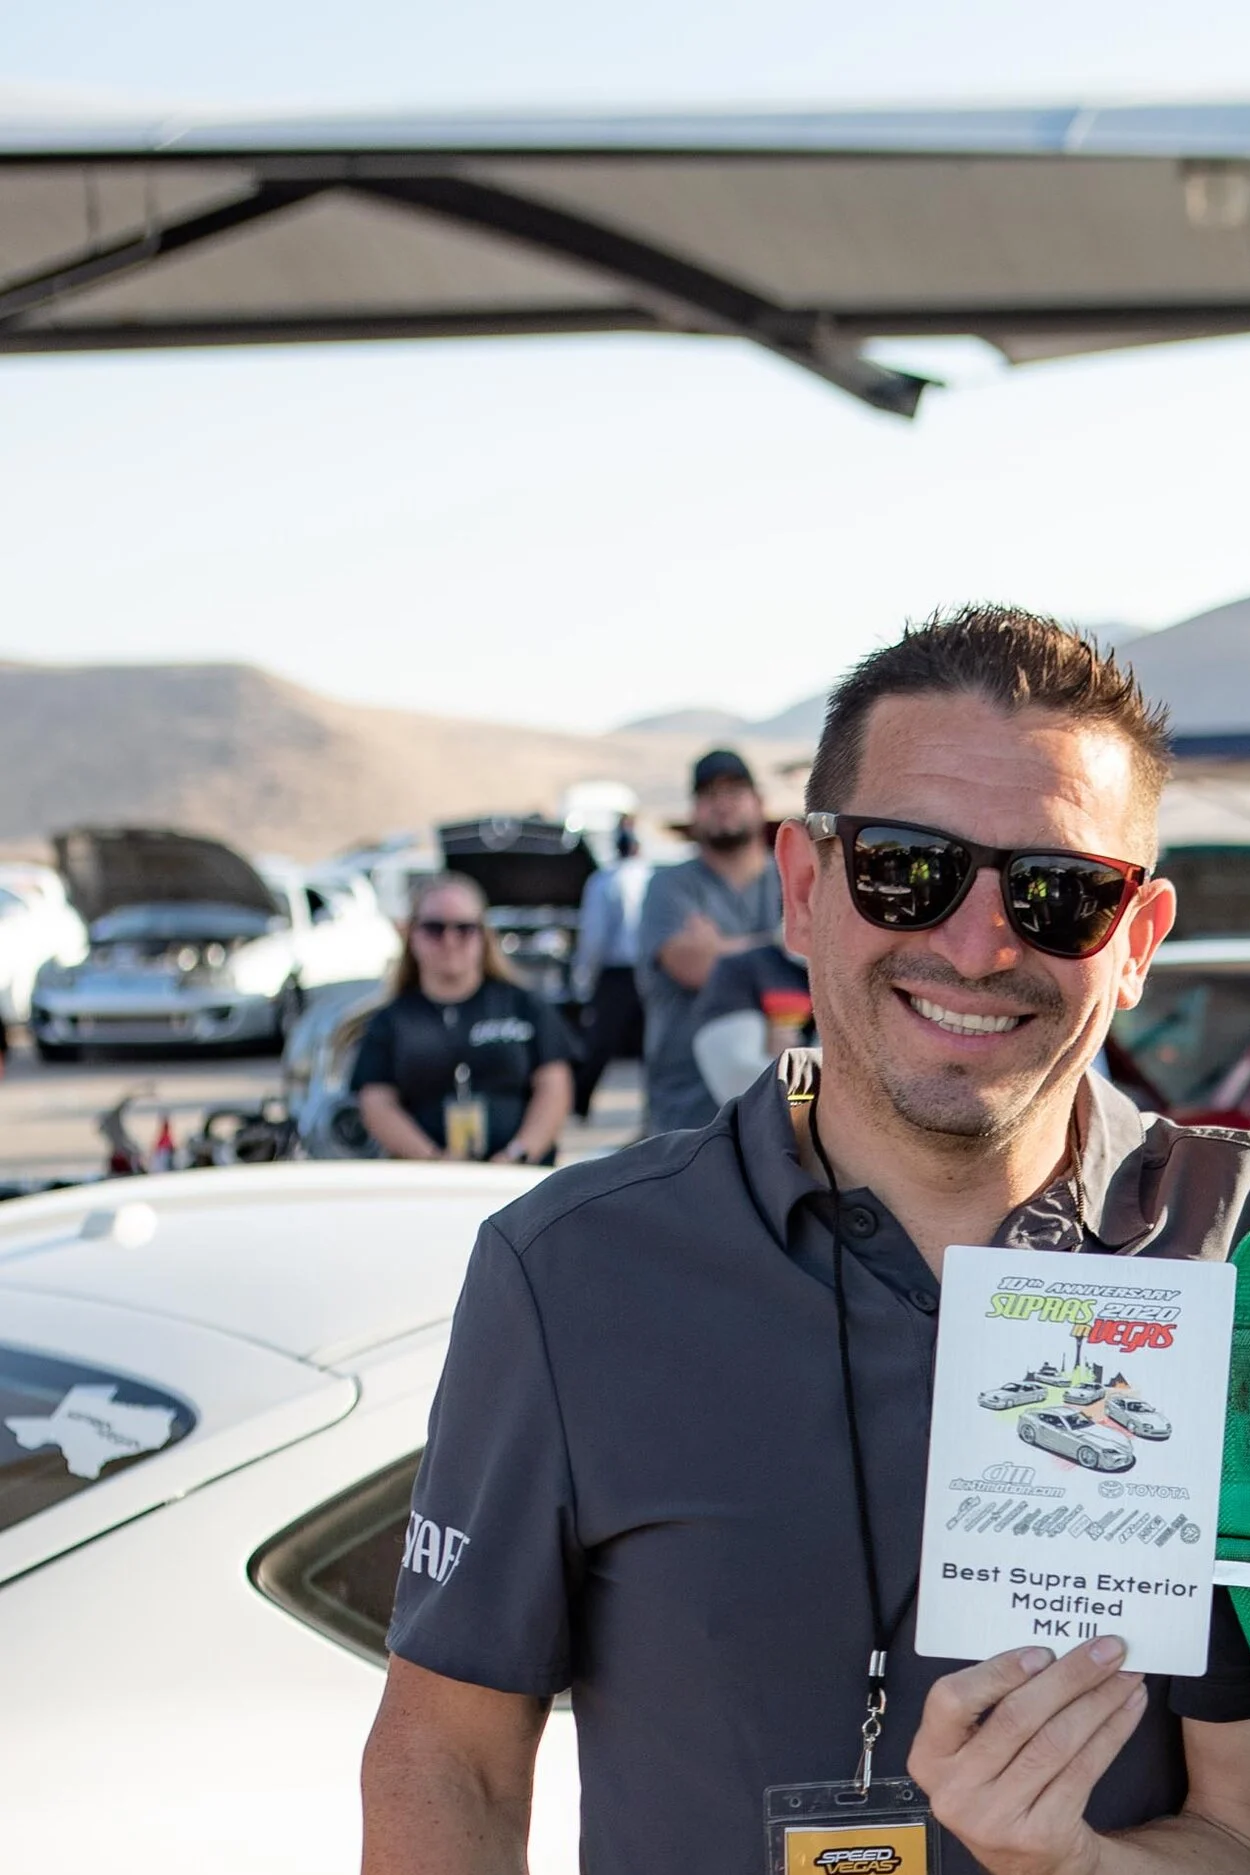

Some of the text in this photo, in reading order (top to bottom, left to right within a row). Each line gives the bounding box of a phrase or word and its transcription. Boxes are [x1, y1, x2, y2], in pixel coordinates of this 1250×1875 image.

[998, 1276, 1181, 1301] 10th ANNIVERSARY
[985, 1292, 1181, 1324] SUPRAS 2020
[1087, 1318, 1177, 1353] VEGAS
[1125, 1483, 1190, 1500] TOYOTA
[942, 1563, 1198, 1598] Best Supra Exterior
[1011, 1592, 1123, 1617] Modified
[1033, 1619, 1099, 1640] MK III
[817, 1848, 893, 1864] SPEED
[827, 1860, 898, 1874] VEGAS
